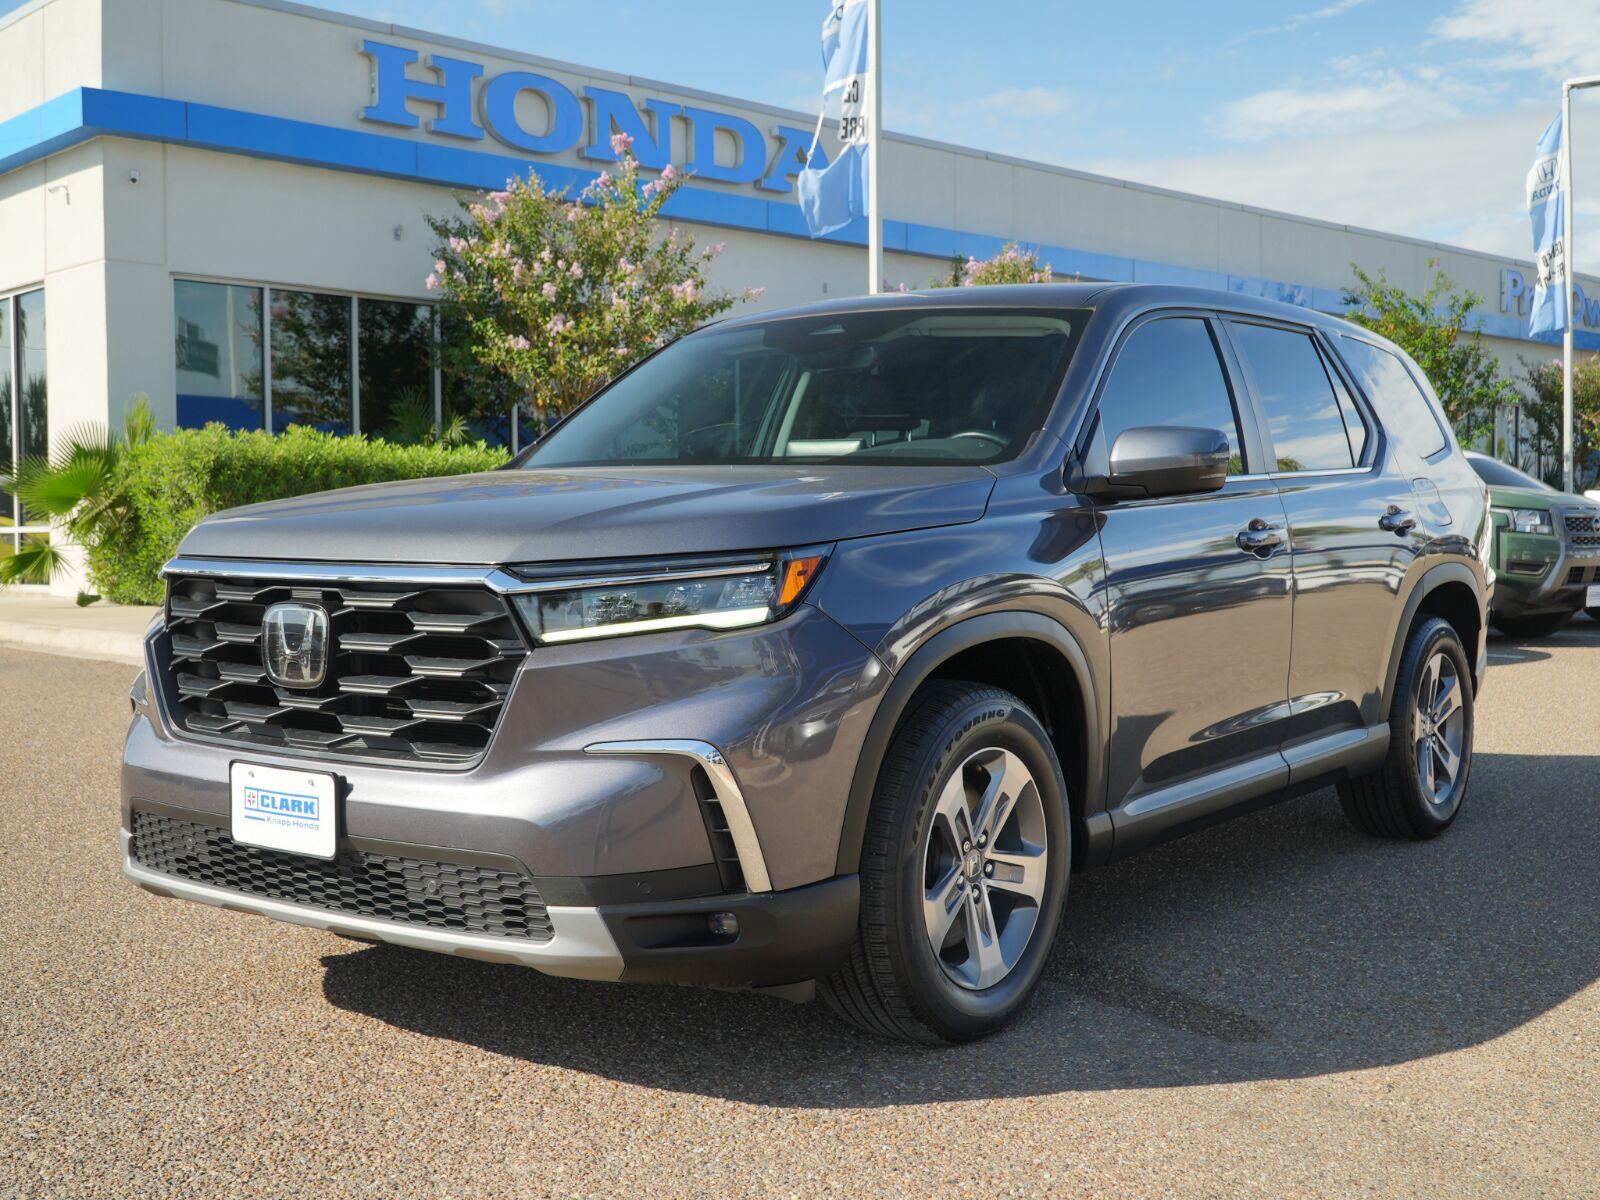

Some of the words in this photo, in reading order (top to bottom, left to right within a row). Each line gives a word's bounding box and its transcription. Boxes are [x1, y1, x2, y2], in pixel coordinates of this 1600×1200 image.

[360, 39, 830, 194] HONDA
[946, 709, 1005, 753] TOURING
[260, 794, 315, 815] CLARK
[266, 815, 292, 827] Knapp
[293, 819, 320, 831] Honda
